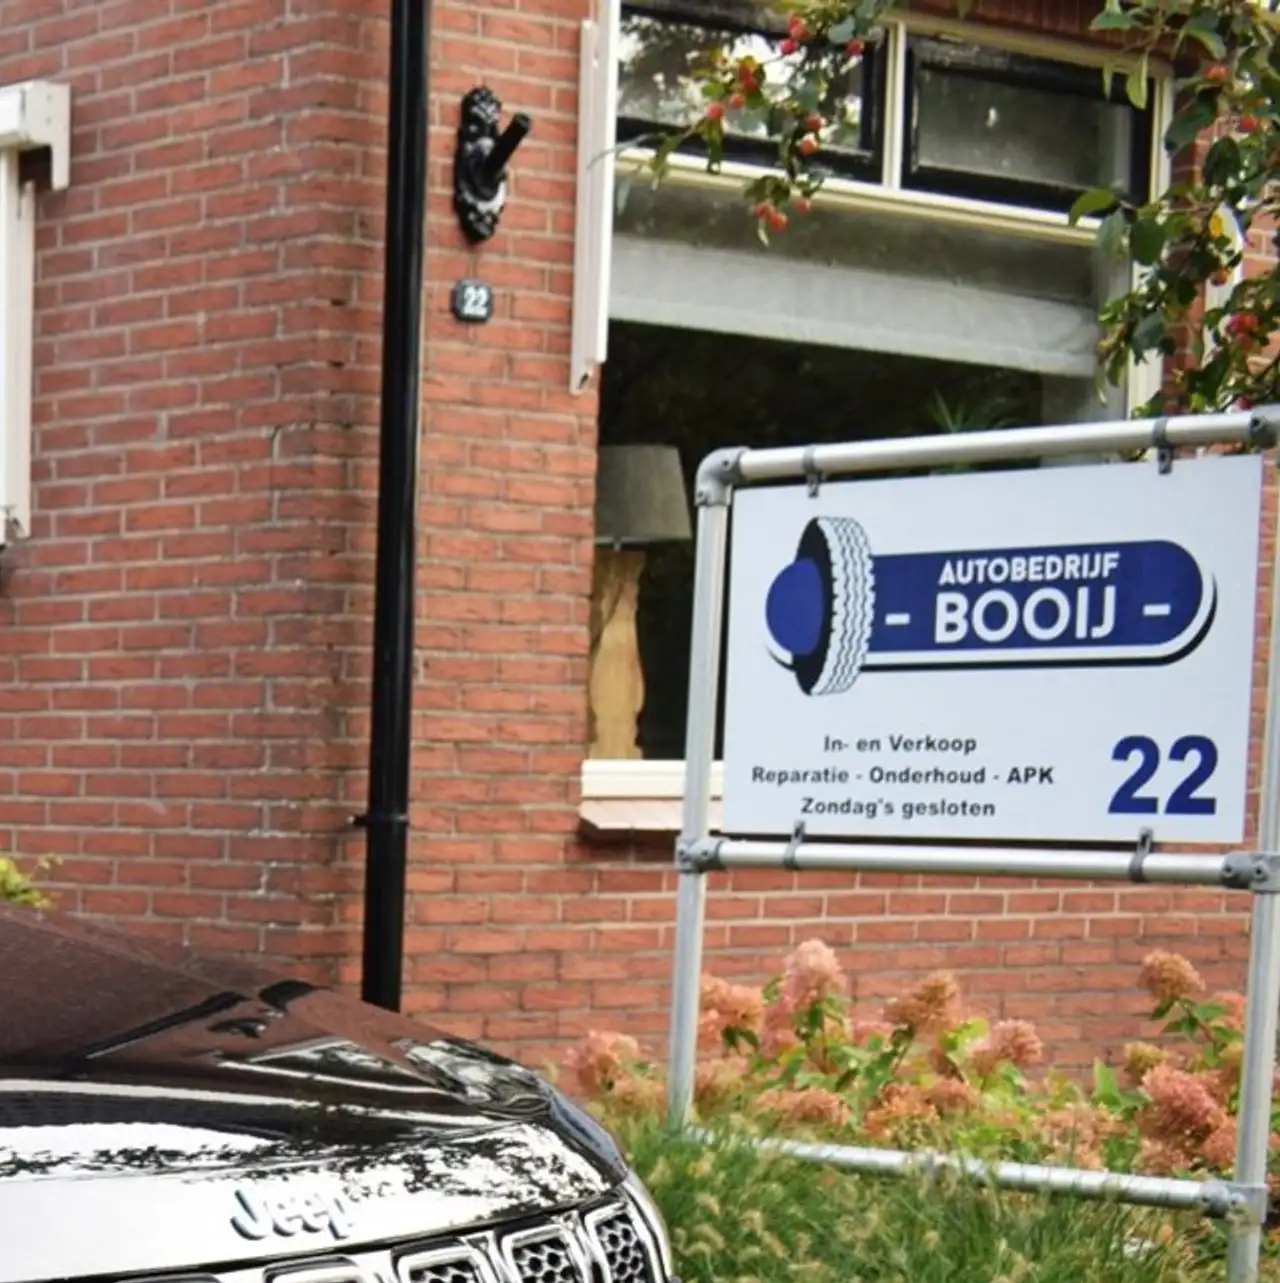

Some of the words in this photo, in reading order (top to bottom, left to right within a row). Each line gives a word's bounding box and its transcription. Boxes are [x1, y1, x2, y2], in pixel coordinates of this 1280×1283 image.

[463, 286, 488, 316] 22
[938, 552, 1120, 586] AUTOBEDRIJF
[934, 585, 1117, 644] BOOIJ
[856, 738, 881, 752] en
[889, 735, 977, 756] Verkoop
[752, 766, 849, 787] Reparatie
[869, 765, 986, 784] Onderhoud
[1006, 765, 1055, 784] APK
[1107, 735, 1219, 816] 22
[801, 797, 894, 819] Zondag's
[902, 799, 996, 819] gesloten
